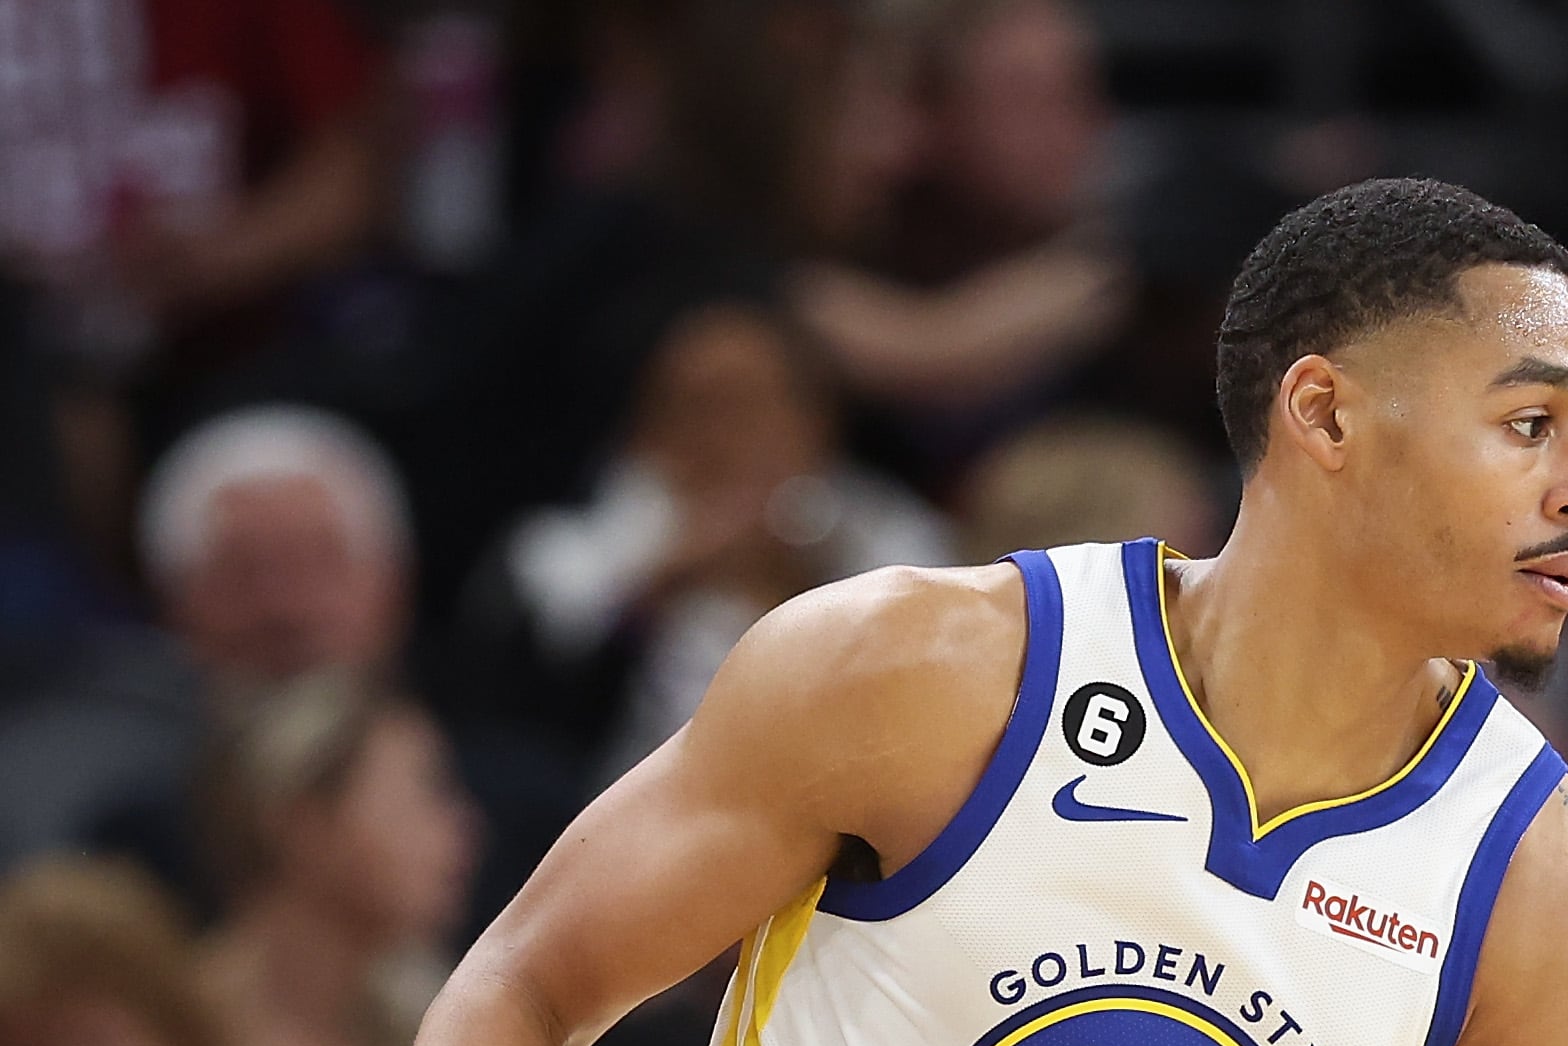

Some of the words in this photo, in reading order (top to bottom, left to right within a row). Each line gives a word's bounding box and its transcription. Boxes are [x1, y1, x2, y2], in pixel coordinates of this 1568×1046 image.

[1076, 694, 1129, 757] 6
[1302, 880, 1439, 958] Rakuten
[990, 940, 1225, 1005] GOLDEN
